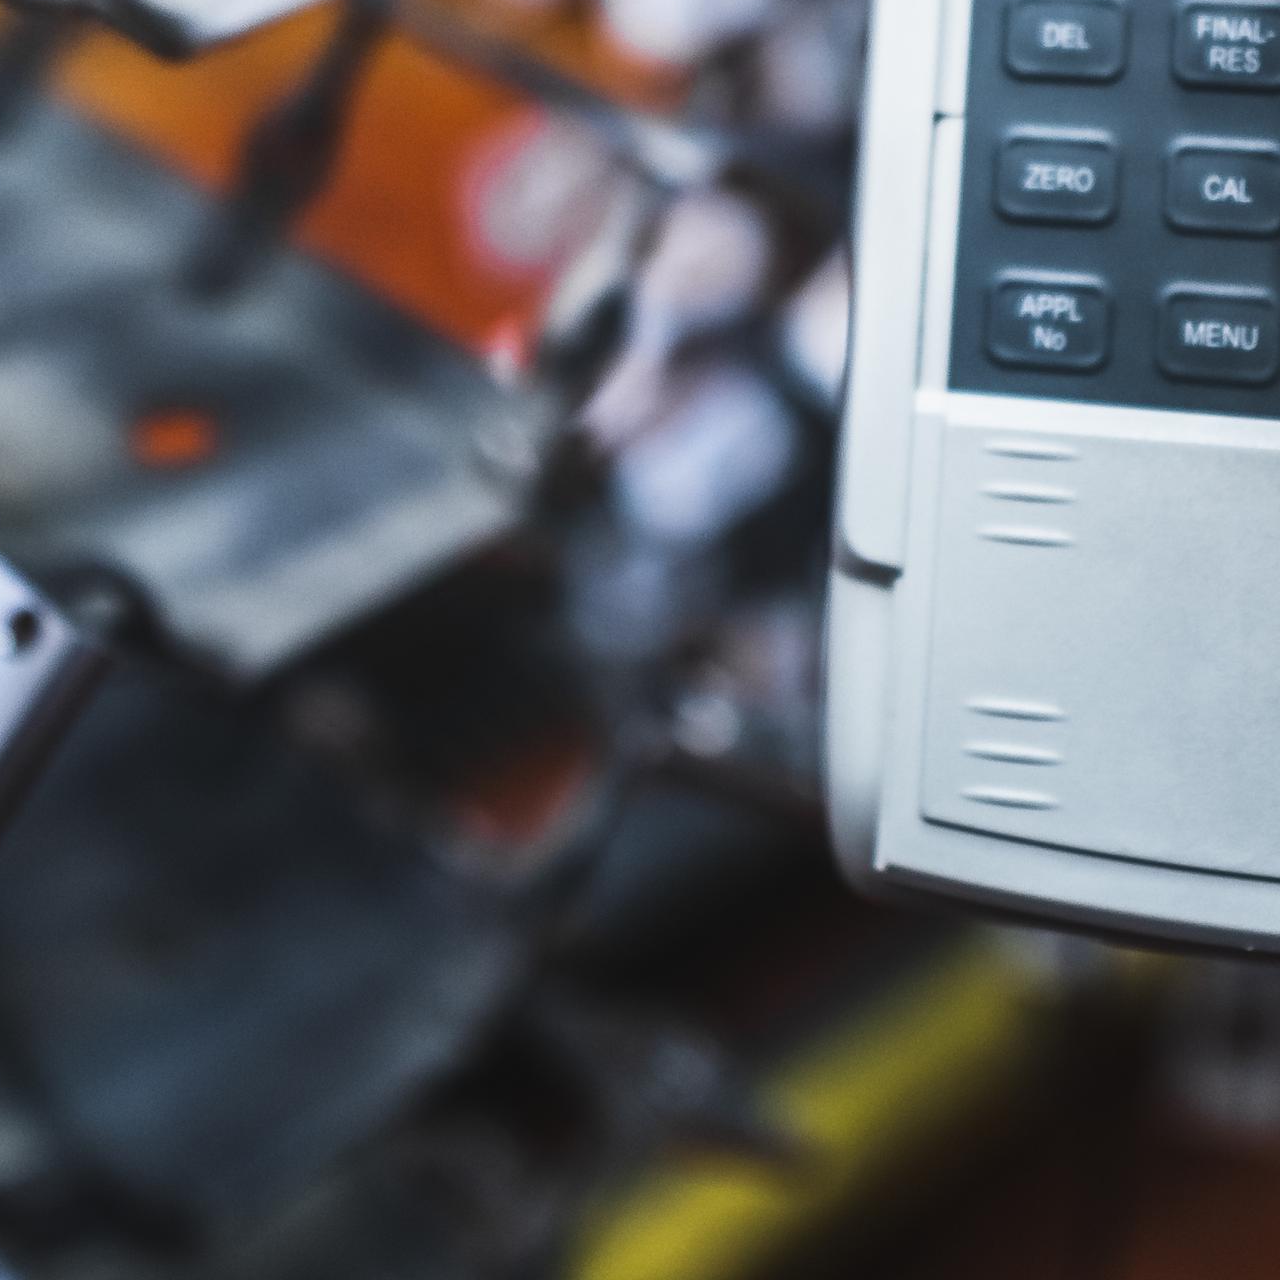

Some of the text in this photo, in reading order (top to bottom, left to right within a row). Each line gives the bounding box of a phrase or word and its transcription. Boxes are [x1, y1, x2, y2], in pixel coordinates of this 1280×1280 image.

[1040, 20, 1091, 50] DEL
[1195, 14, 1276, 45] FINAL-
[1209, 45, 1262, 74] RES
[1022, 162, 1096, 194] ZERO
[1202, 173, 1253, 204] CAL
[1019, 294, 1084, 322] APPL
[1032, 325, 1067, 353] No
[1183, 321, 1260, 353] MENU
